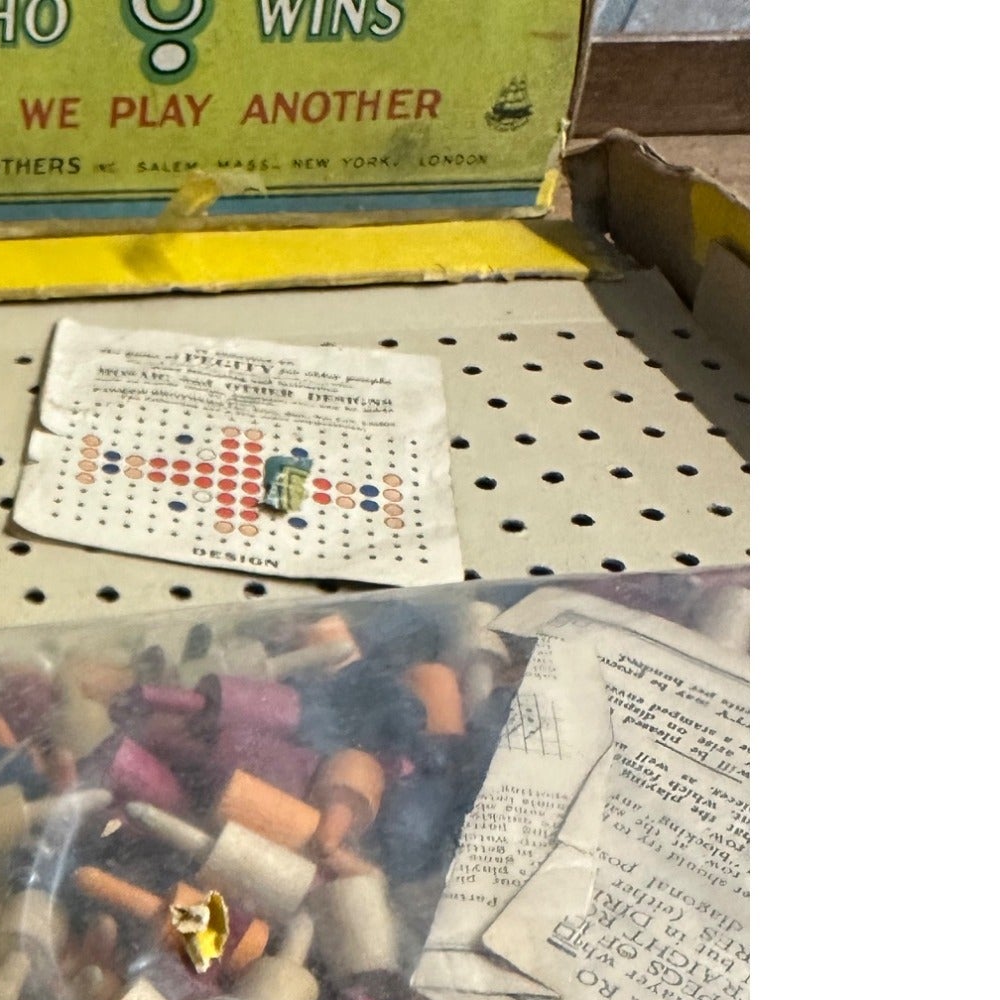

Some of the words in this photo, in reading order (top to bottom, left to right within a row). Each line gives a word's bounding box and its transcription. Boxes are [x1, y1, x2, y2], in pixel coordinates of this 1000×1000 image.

[260, 0, 403, 38] WINS
[19, 97, 82, 130] WE
[109, 93, 213, 129] PLAY
[239, 89, 443, 126] ANOTHER
[291, 157, 331, 171] NEW
[418, 153, 489, 167] LONDON
[191, 546, 281, 569] DESIGN
[666, 722, 687, 735] on
[690, 746, 708, 761] be
[619, 769, 683, 803] playing
[668, 780, 717, 809] which
[690, 805, 717, 823] the
[648, 877, 744, 932] diagonal
[665, 925, 683, 945] in
[697, 945, 735, 972] but
